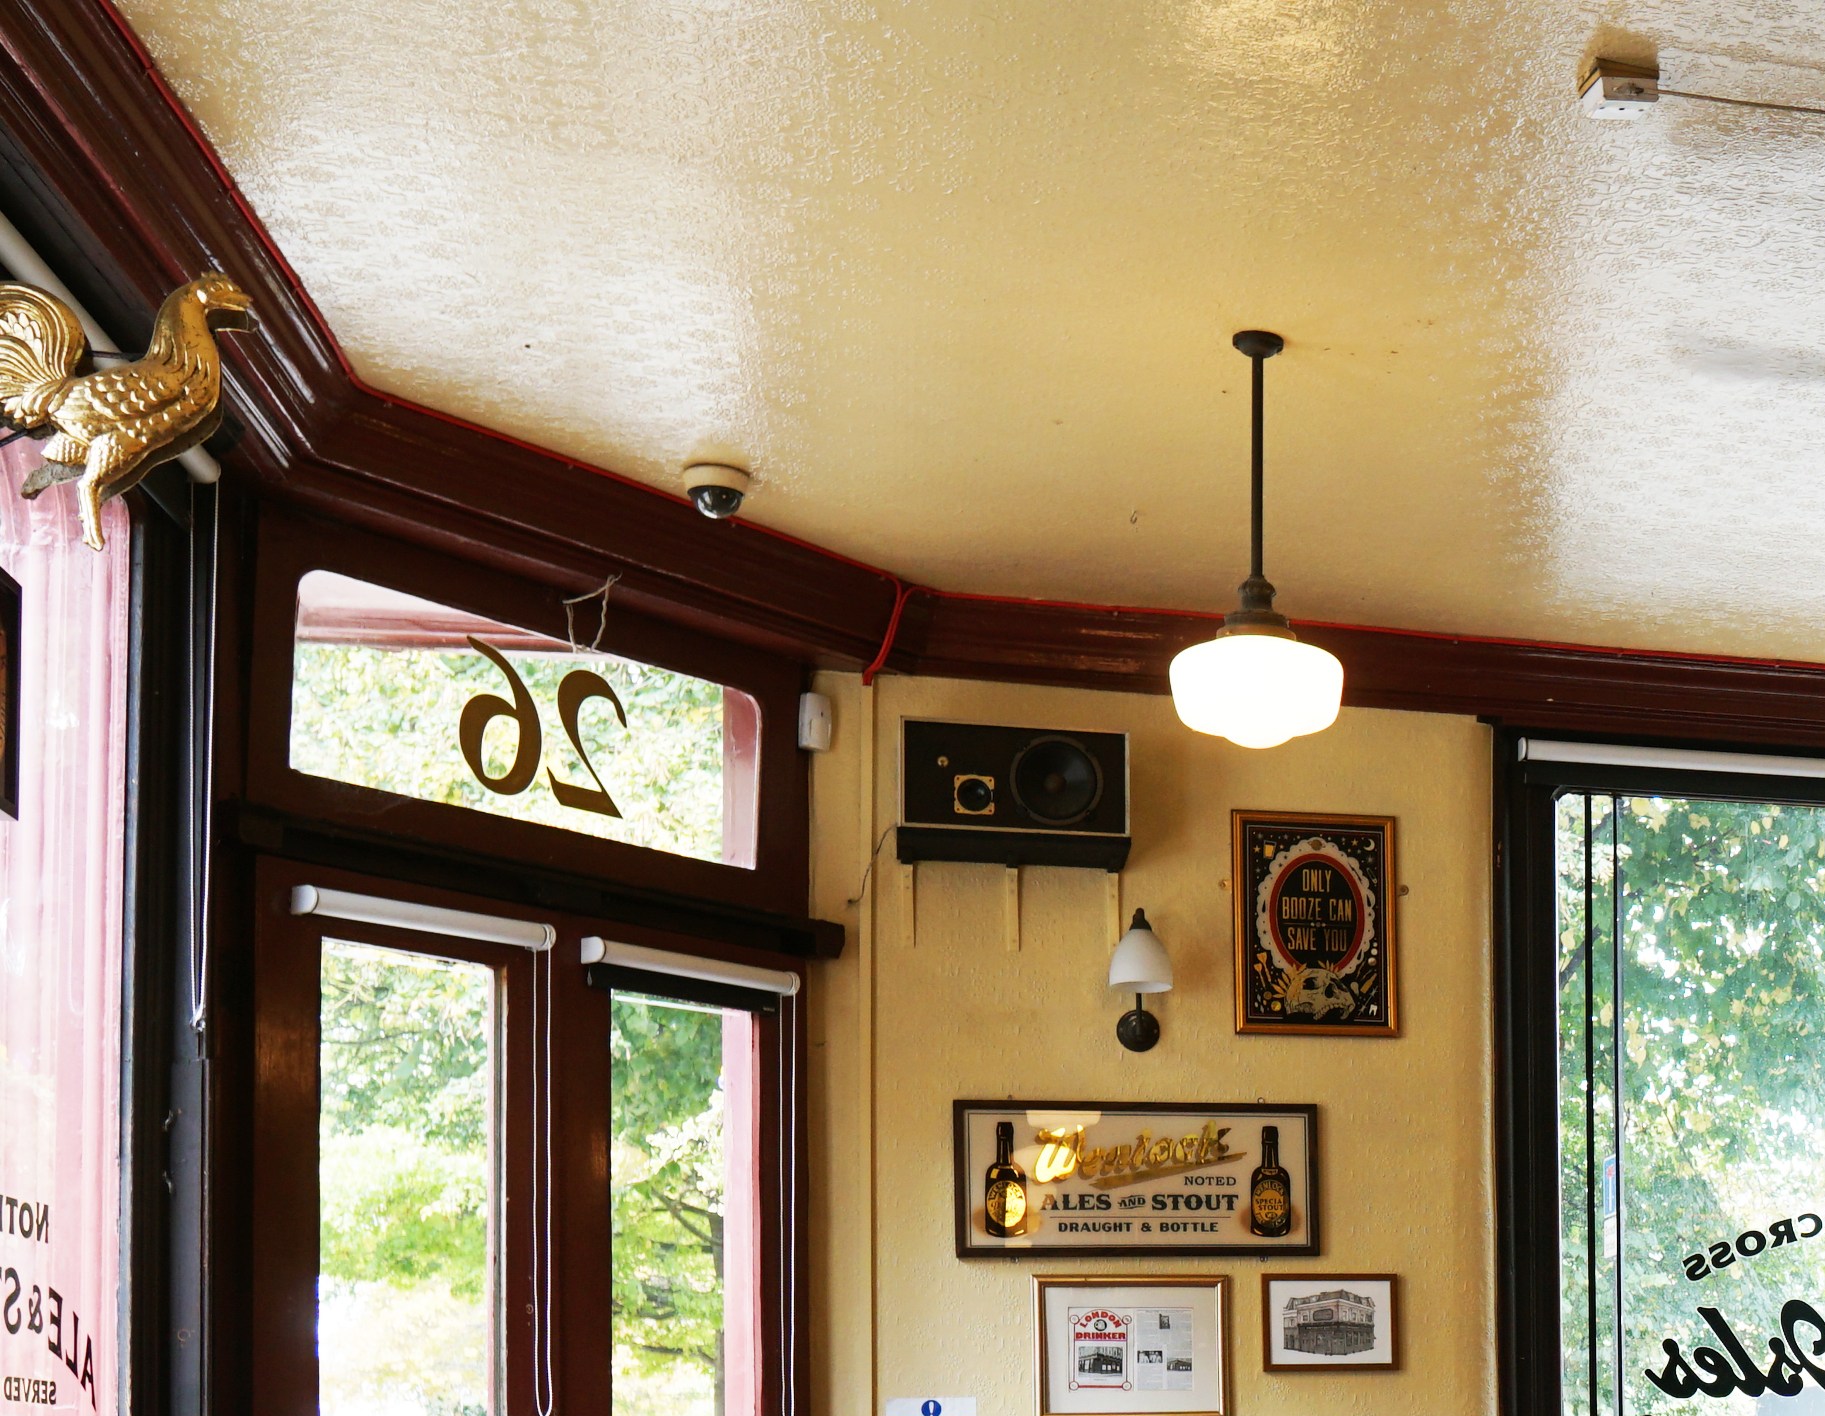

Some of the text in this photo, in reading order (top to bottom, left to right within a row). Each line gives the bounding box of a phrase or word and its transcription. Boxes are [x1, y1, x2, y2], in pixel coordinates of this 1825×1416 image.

[1302, 869, 1332, 893] ONLY
[1282, 897, 1352, 922] BOOZE CAN
[1287, 927, 1348, 952] SAVE YOU
[1184, 1176, 1236, 1187] NOTED
[1041, 1193, 1239, 1211] ALES AND STOUT
[1058, 1222, 1219, 1233] DRAUGHT & BOTTLE
[1080, 1311, 1121, 1328] LONDON
[1075, 1332, 1126, 1340] DRINKER
